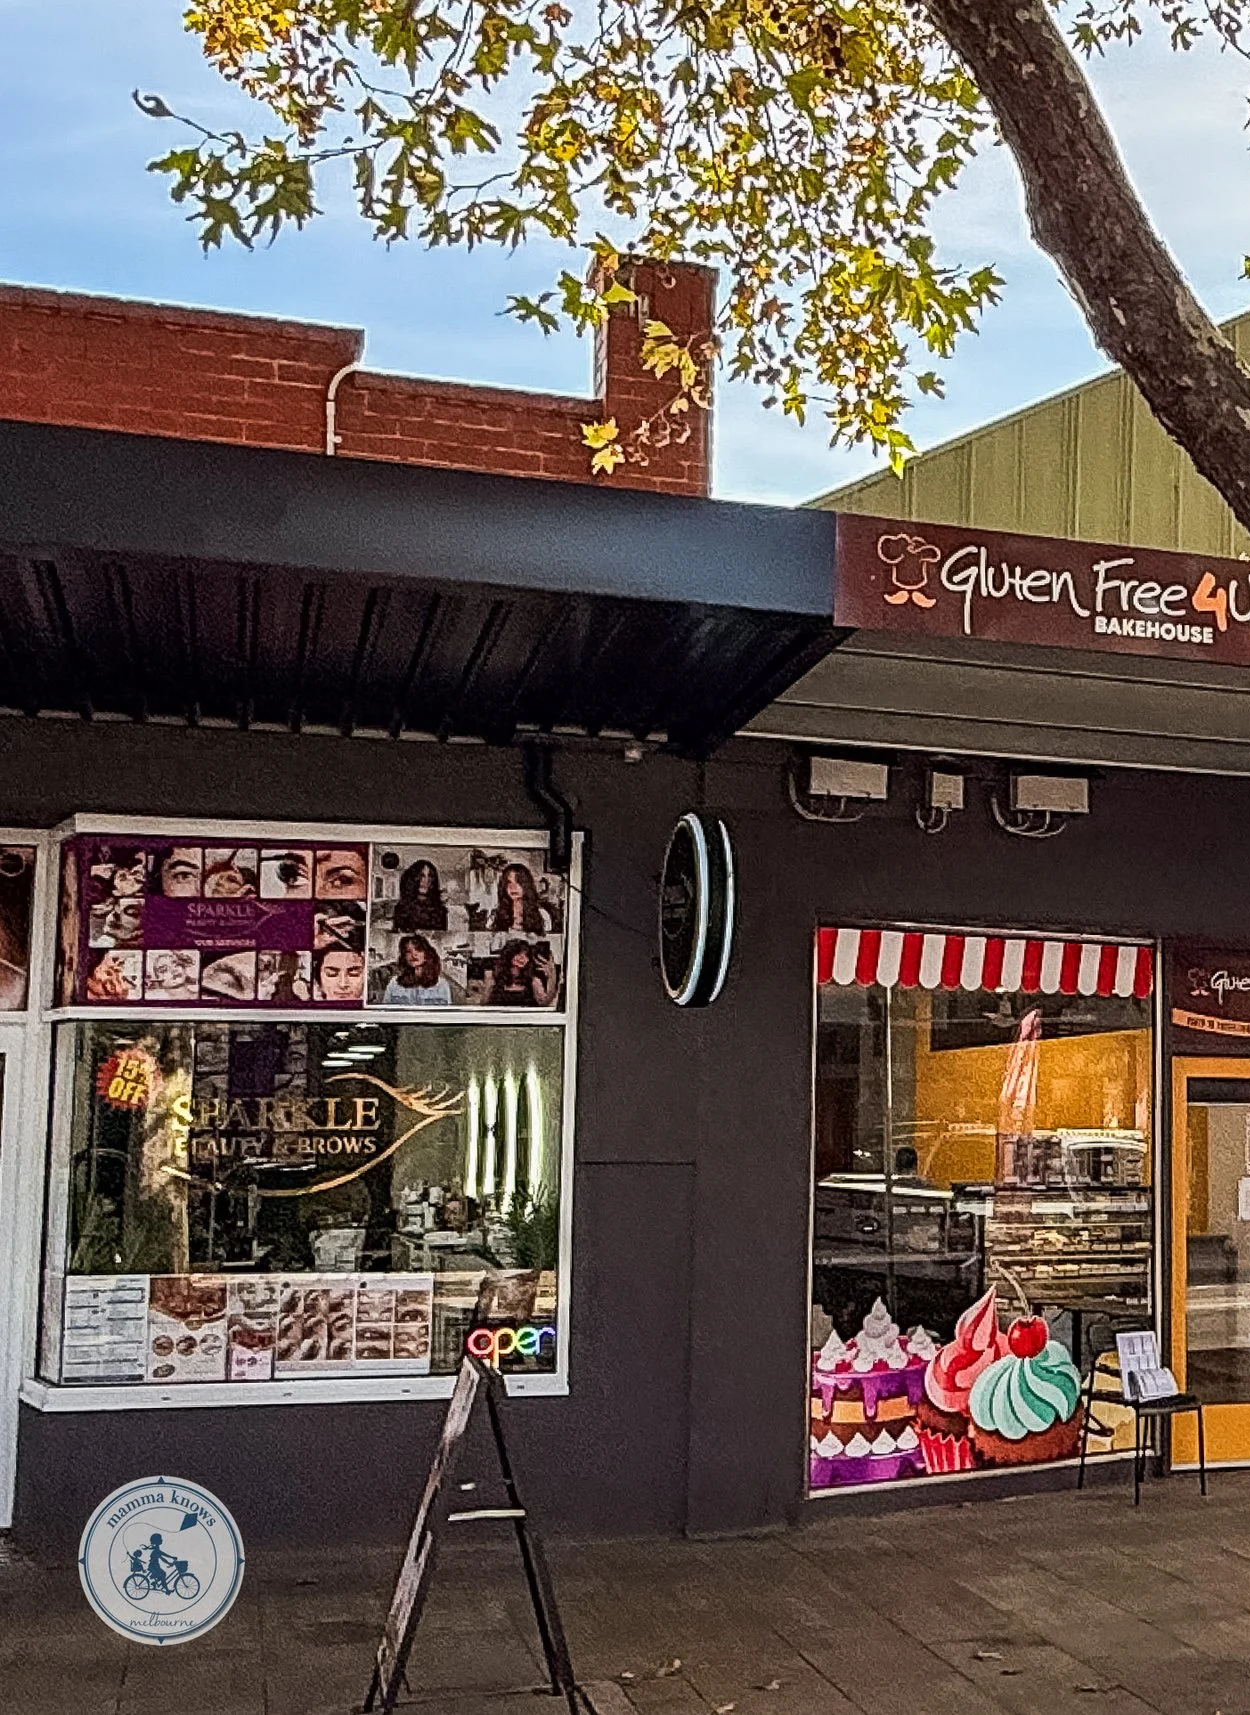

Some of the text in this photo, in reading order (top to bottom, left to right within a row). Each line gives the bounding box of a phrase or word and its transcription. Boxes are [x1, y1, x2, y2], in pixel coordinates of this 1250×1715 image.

[940, 545, 1091, 634] Gluten
[1095, 616, 1214, 644] BAKEHOUSE
[187, 902, 256, 918] SPARKLE
[108, 1077, 147, 1104] OFF
[172, 1096, 381, 1131] SPARKLE
[299, 1136, 377, 1155] BROWS
